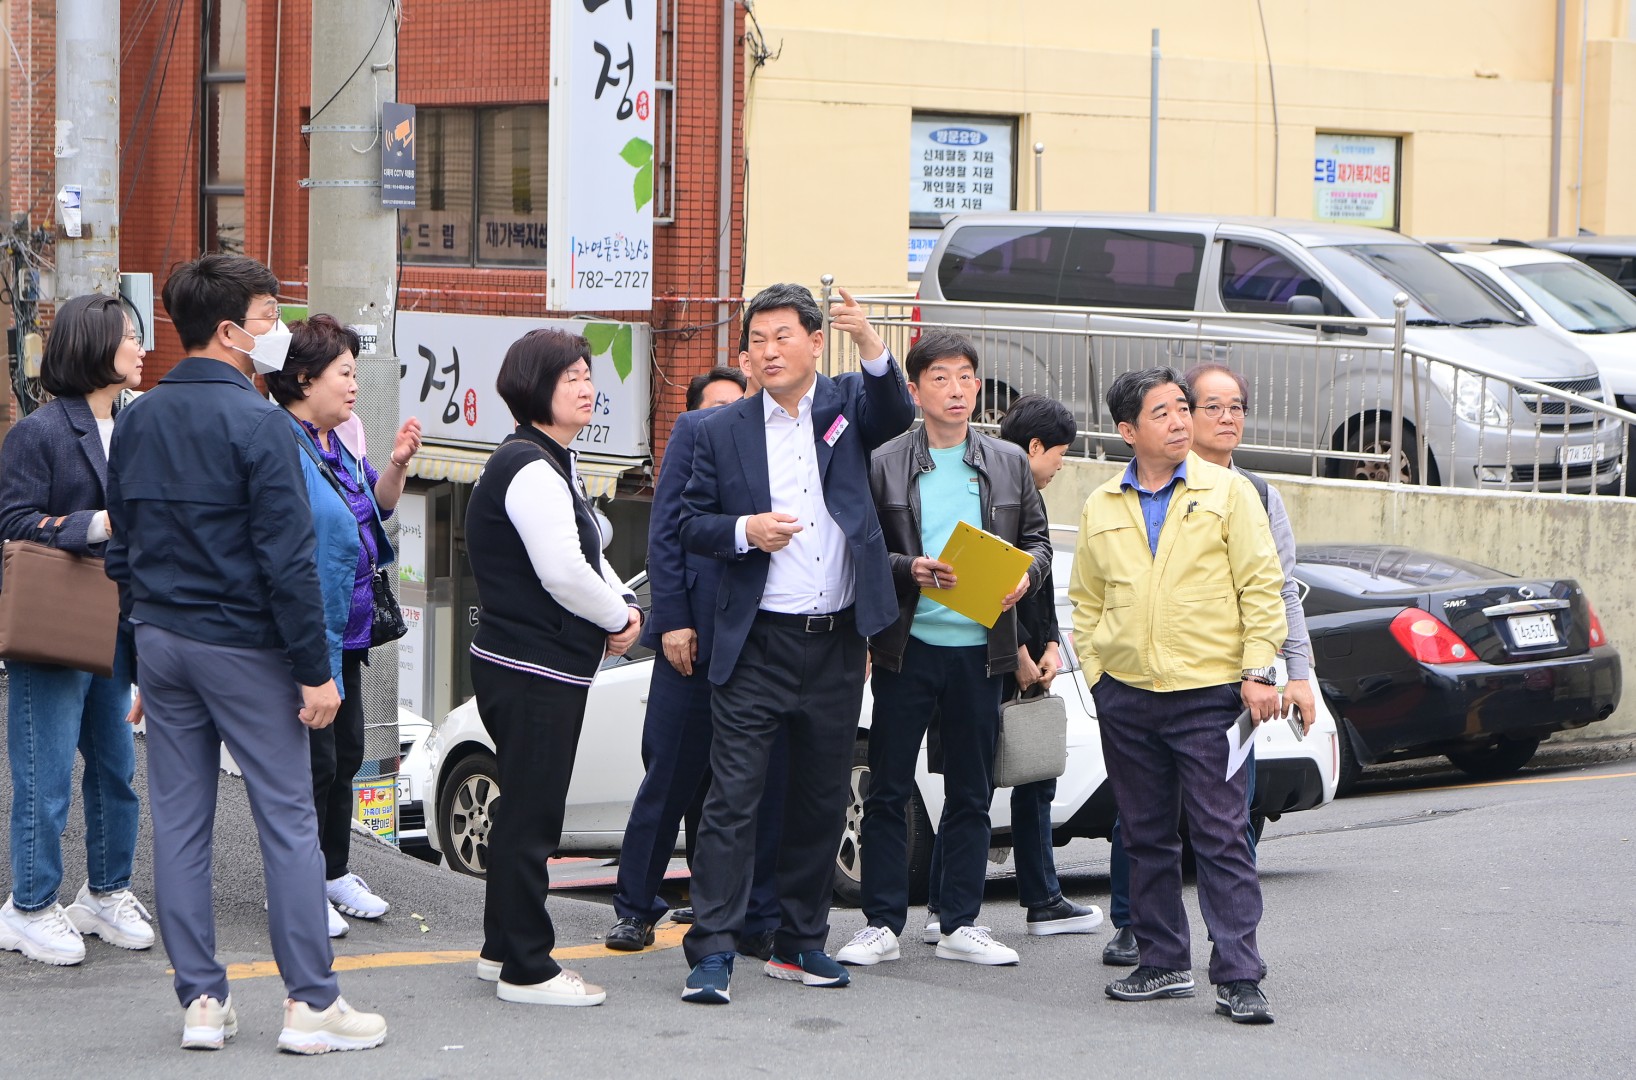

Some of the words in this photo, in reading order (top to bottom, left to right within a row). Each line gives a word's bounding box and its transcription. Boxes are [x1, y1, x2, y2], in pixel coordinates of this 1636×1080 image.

[973, 151, 994, 163] 지원
[923, 165, 966, 177] 일상생활
[973, 167, 993, 178] 지원
[1314, 158, 1336, 183] 드림
[1338, 163, 1390, 184] 재가복지센터
[923, 181, 966, 193] 개인활동
[973, 182, 993, 194] 지원
[934, 197, 955, 209] 정서
[961, 198, 982, 210] 지원
[577, 270, 649, 288] 782-2727
[400, 343, 461, 424] 정
[594, 391, 610, 415] 상
[576, 424, 610, 444] 2727
[1443, 599, 1467, 608] SM5
[363, 808, 380, 816] 가족이
